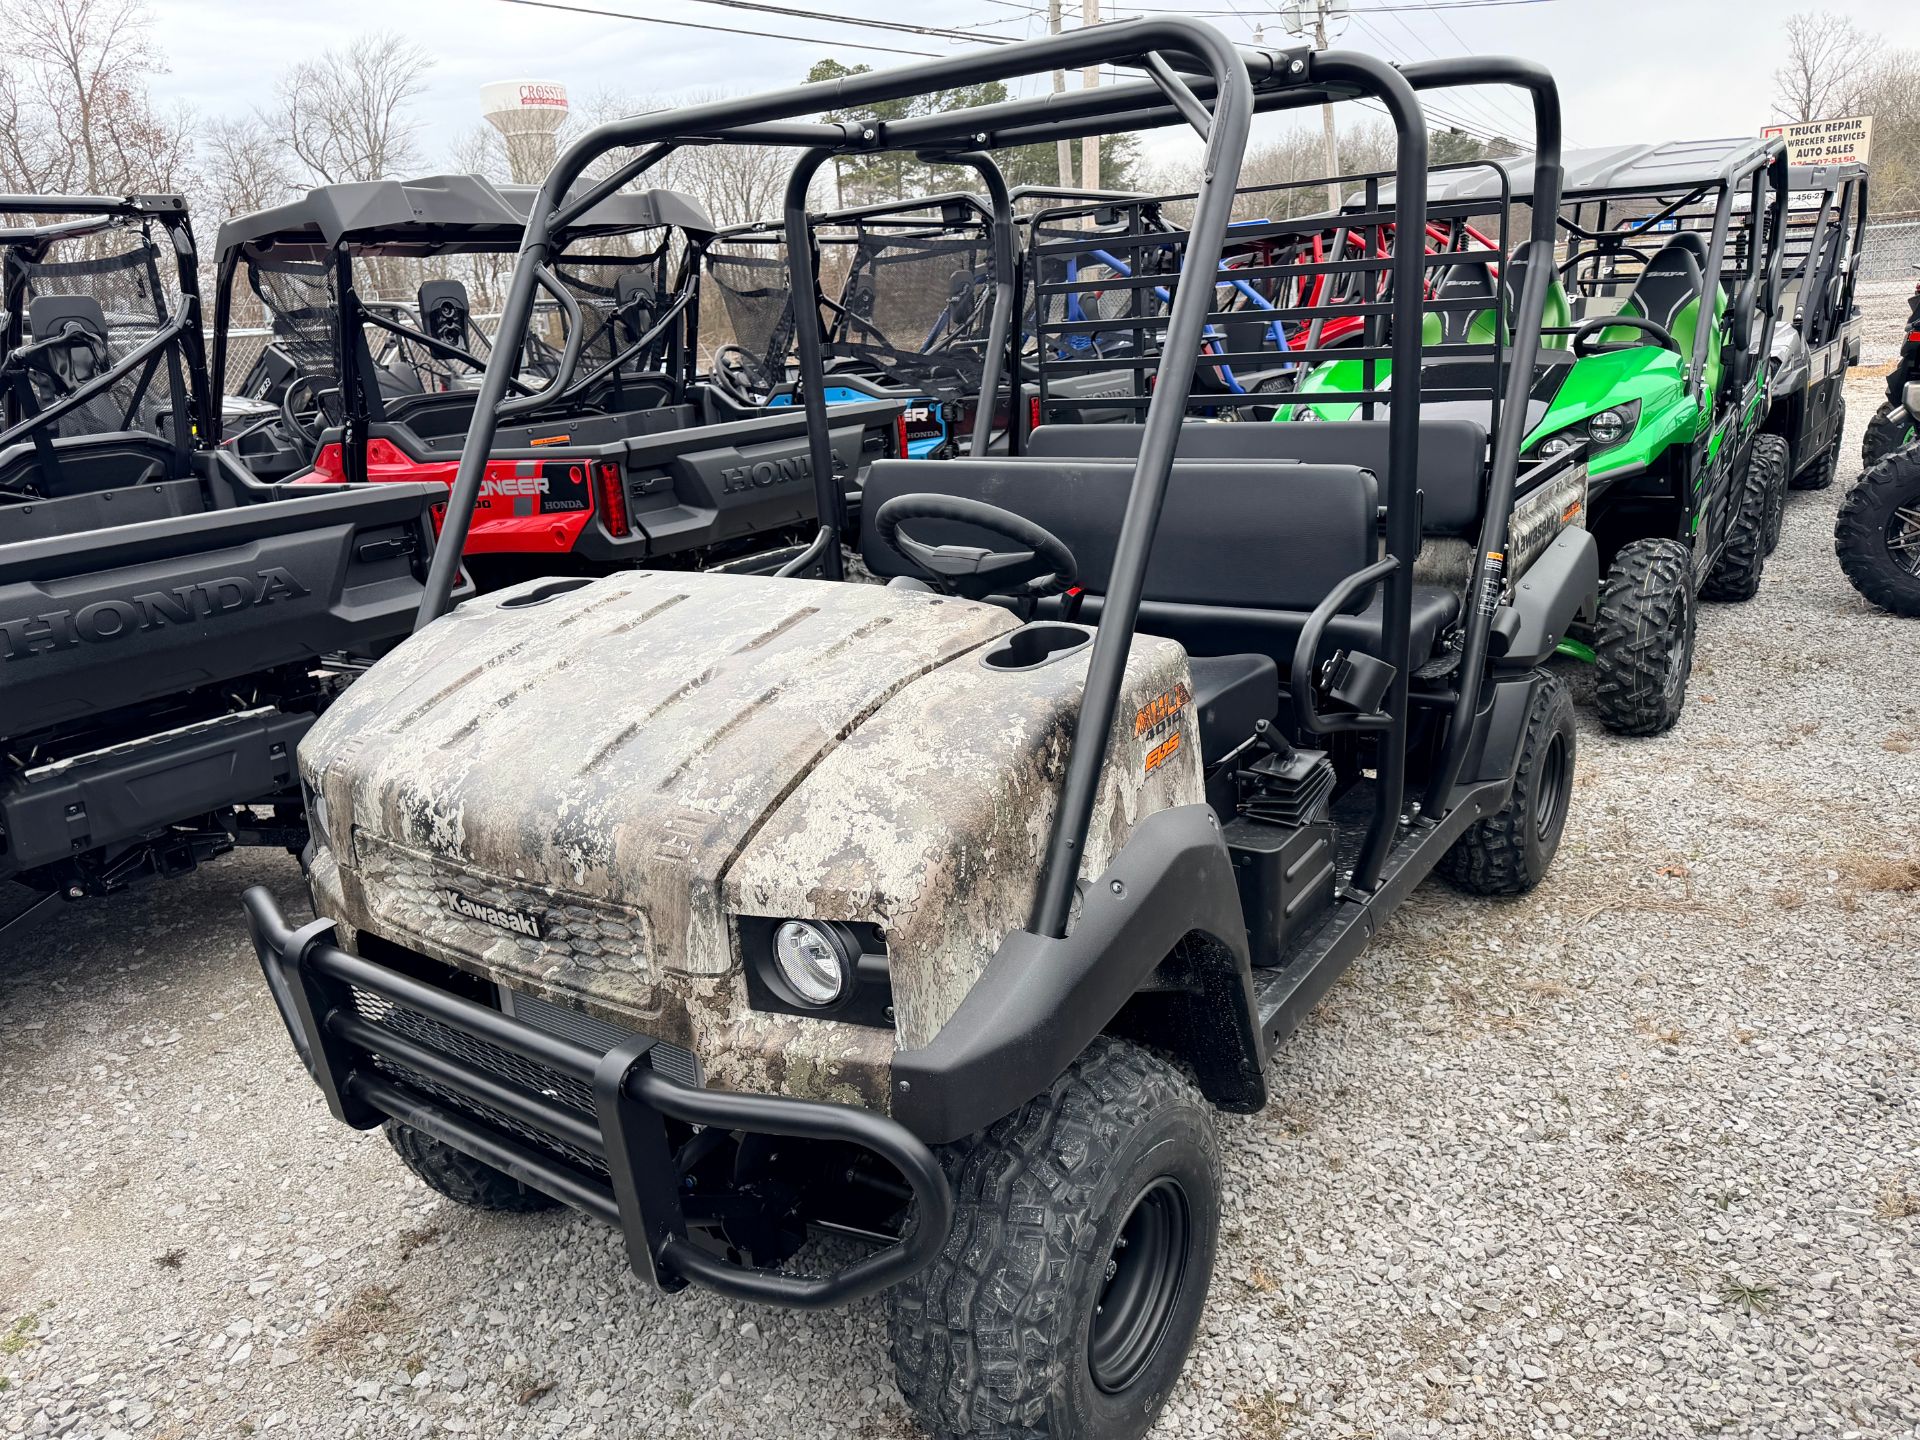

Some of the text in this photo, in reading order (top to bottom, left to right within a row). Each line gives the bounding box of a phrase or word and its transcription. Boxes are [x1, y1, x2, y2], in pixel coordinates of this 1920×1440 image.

[1789, 120, 1863, 137] TRUCK REPAIR
[1787, 131, 1866, 148] WRECKER SERVICES
[1796, 143, 1855, 158] AUTO SALES
[907, 430, 941, 439] HONDA
[451, 477, 551, 497] ONEER
[544, 500, 584, 511] HONDA
[0, 566, 311, 659] HONDA
[1146, 709, 1183, 741] 4010
[1145, 731, 1180, 773] EPS
[445, 889, 540, 938] Kawasaki
